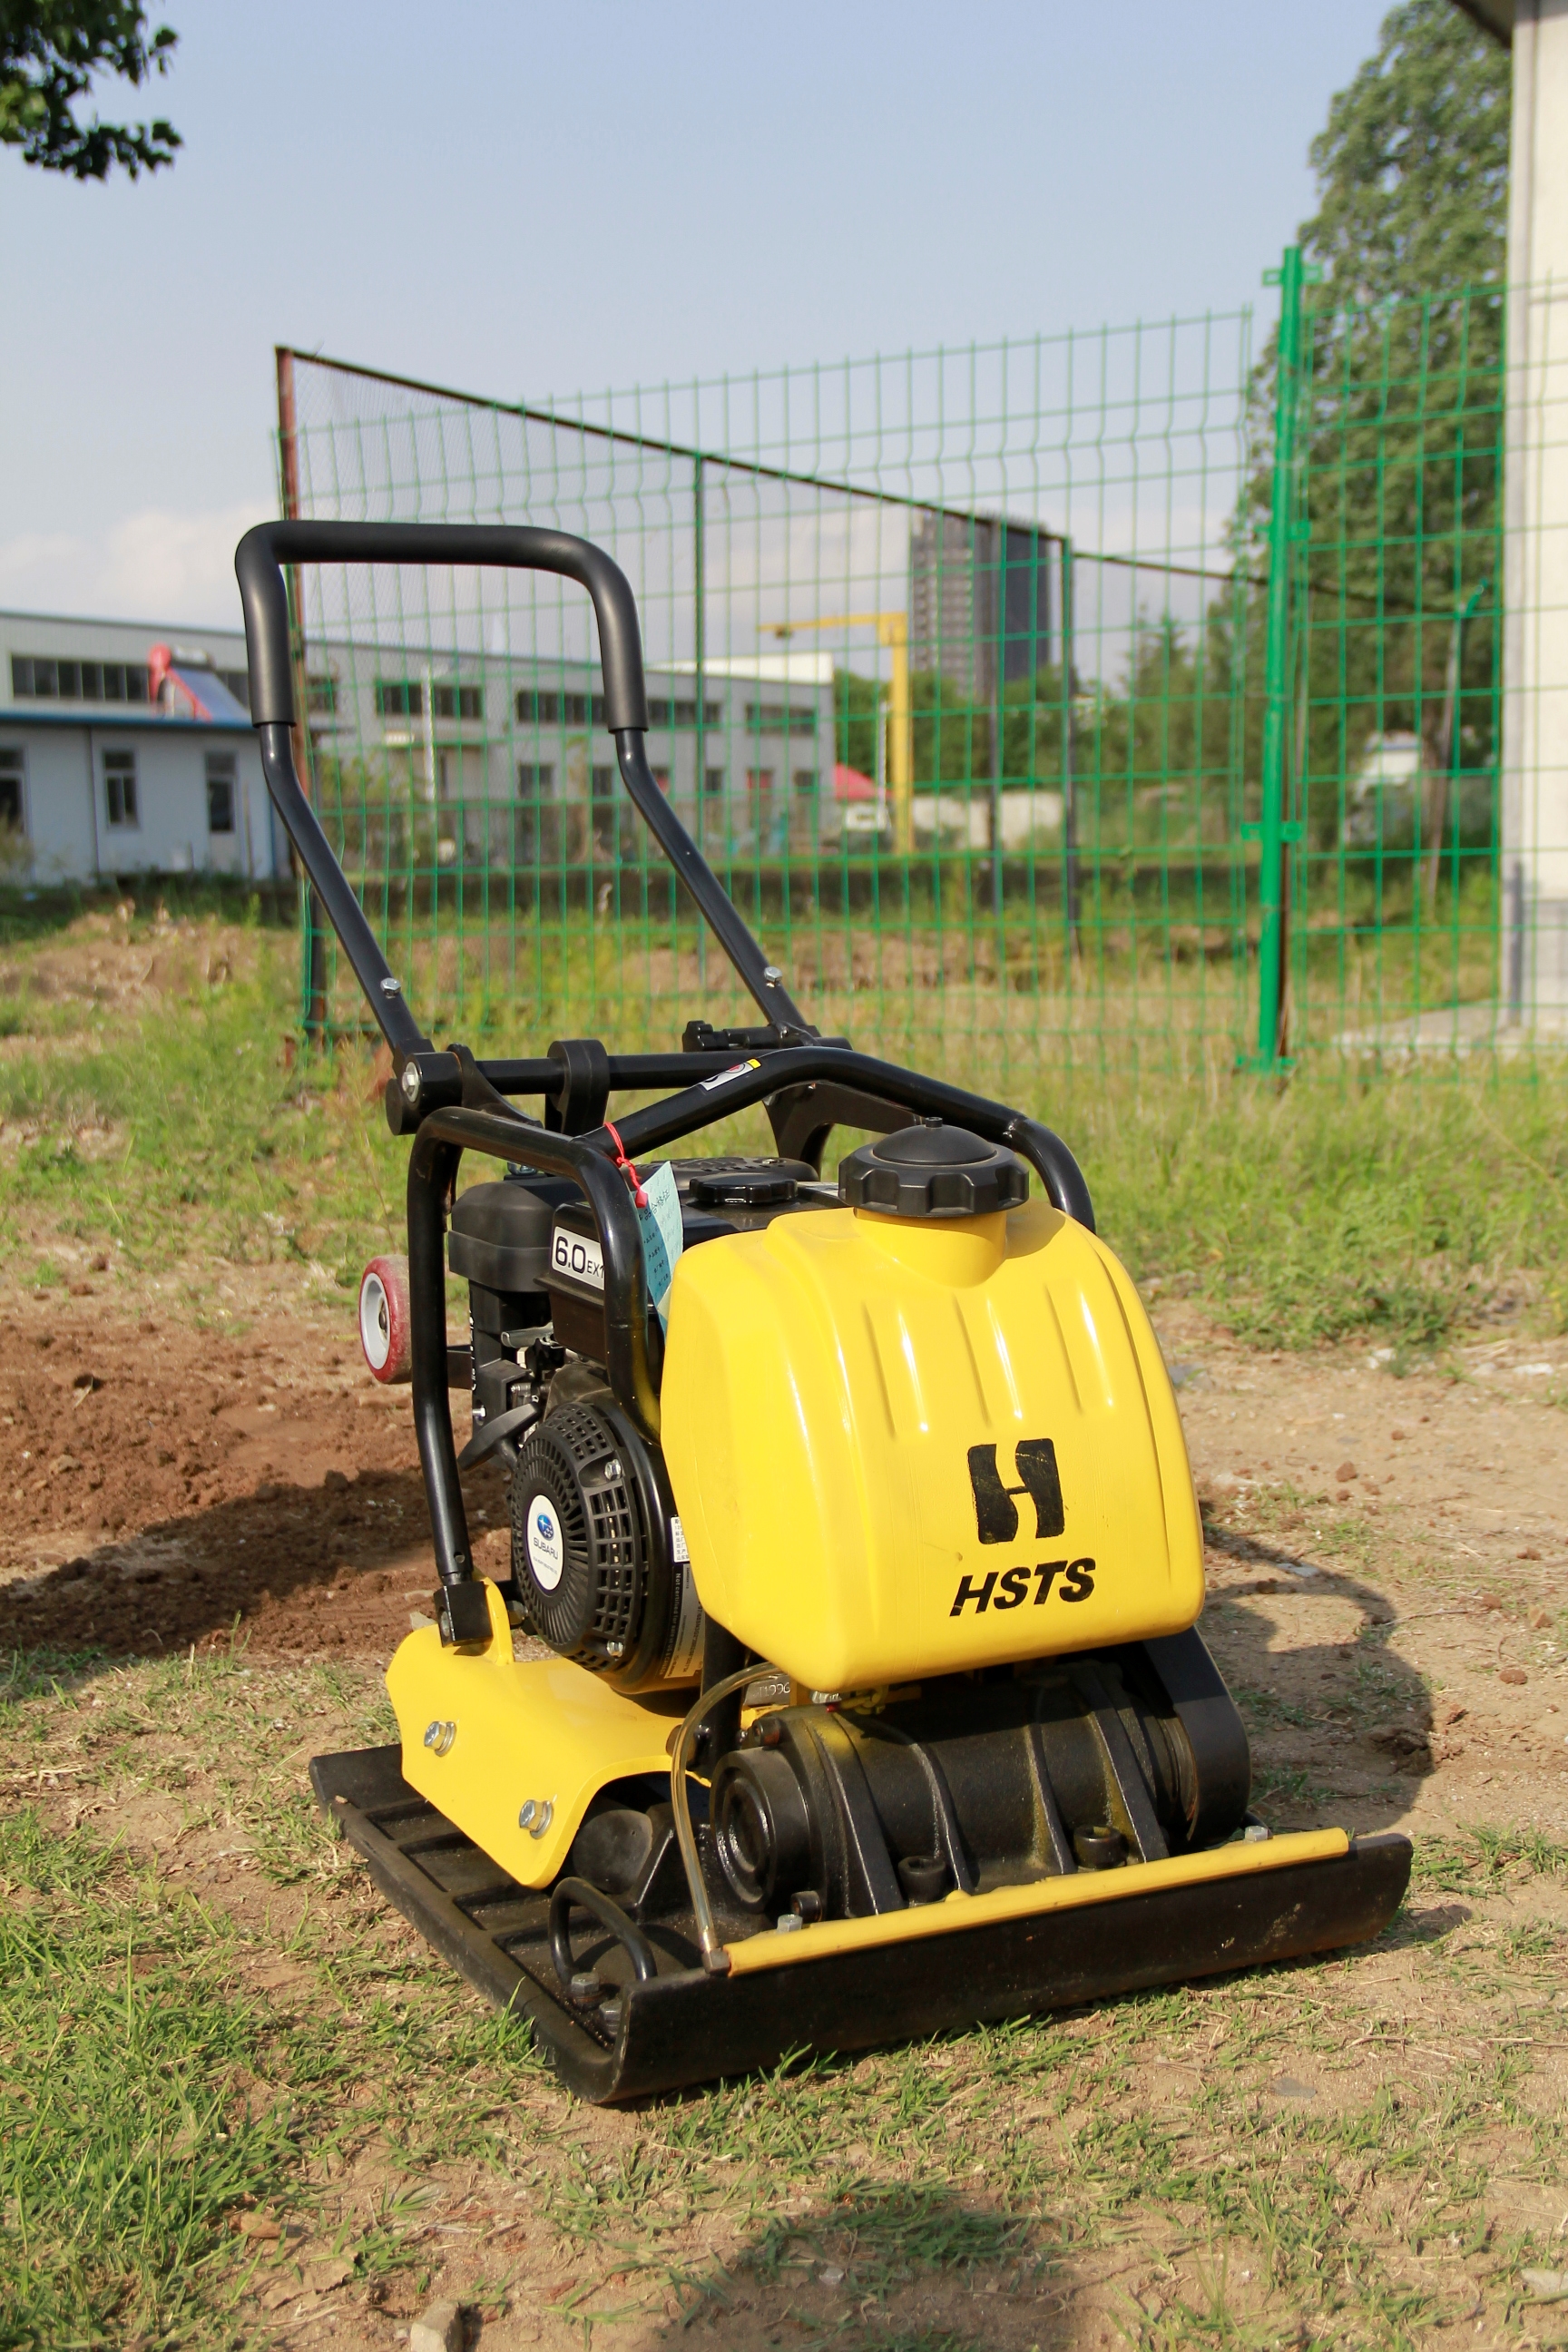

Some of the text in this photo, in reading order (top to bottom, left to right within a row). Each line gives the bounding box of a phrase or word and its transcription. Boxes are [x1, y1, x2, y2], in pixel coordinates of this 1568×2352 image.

[555, 1235, 586, 1274] 6.0
[534, 1537, 558, 1560] SUBARU
[949, 1557, 1096, 1617] HSTS
